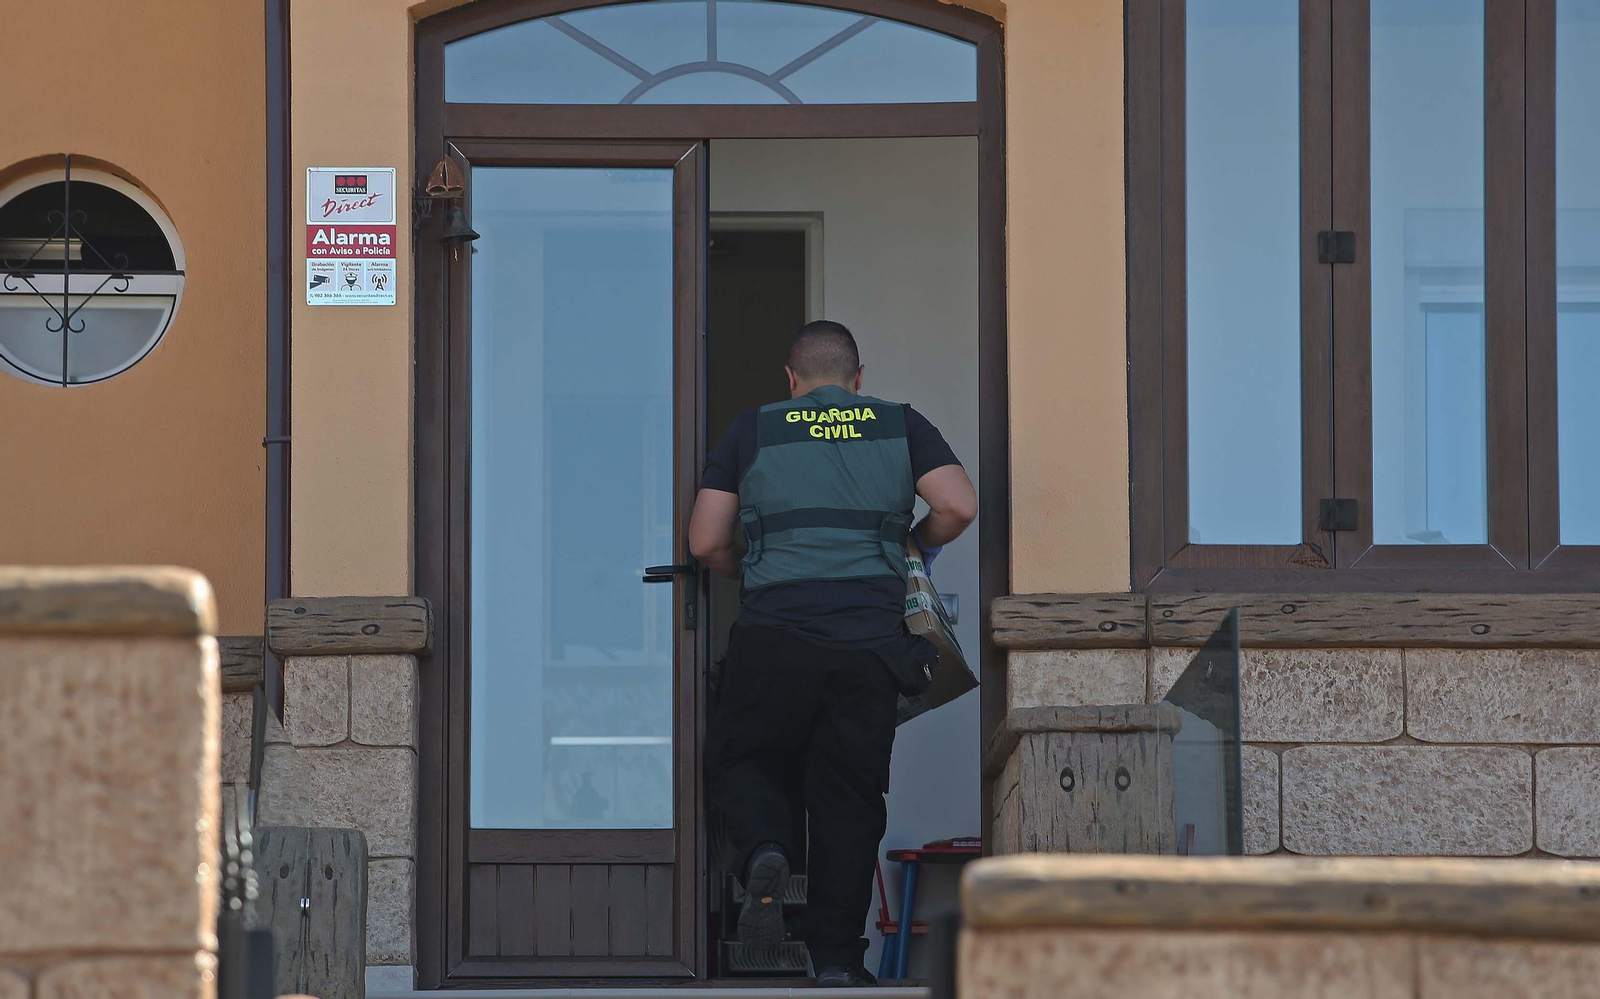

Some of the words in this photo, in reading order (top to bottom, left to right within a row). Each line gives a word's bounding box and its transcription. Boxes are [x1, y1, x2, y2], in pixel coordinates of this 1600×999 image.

[321, 192, 383, 218] Direct
[312, 227, 391, 245] Alarma
[329, 247, 352, 255] Aviso
[363, 247, 391, 255] Policía
[786, 407, 877, 424] GUARDIA
[809, 424, 863, 440] CIVIL
